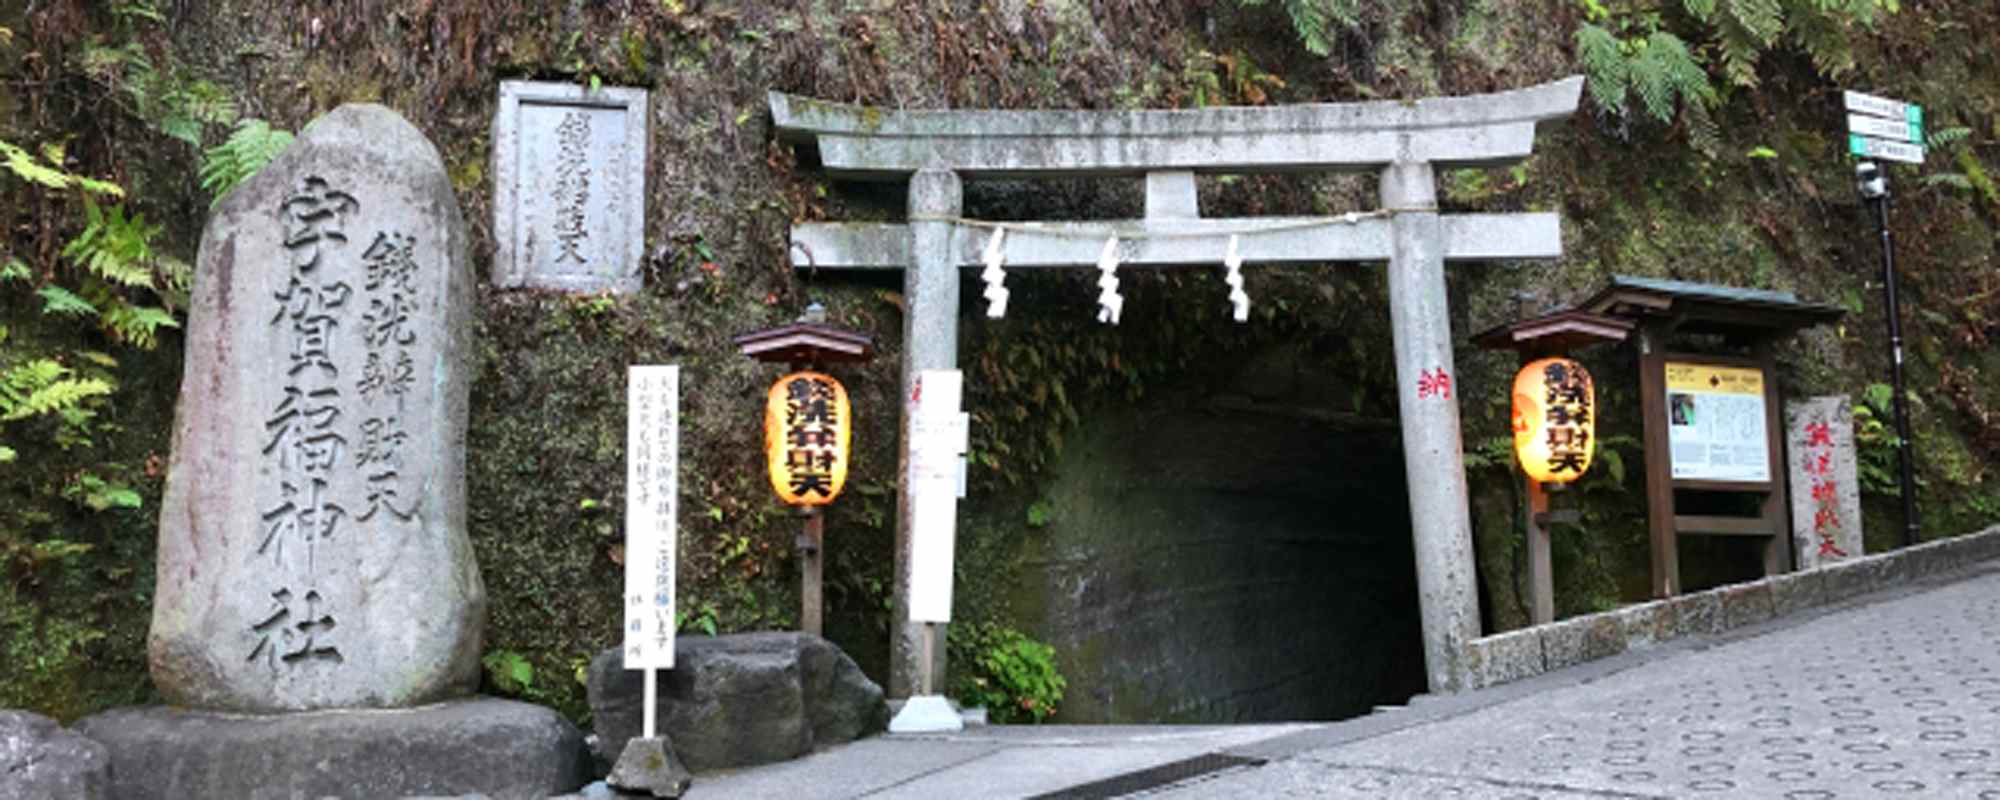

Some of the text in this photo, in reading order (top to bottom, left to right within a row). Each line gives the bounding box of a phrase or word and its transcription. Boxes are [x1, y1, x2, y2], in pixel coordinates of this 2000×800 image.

[246, 175, 361, 667] 宇賀福神社
[1417, 367, 1452, 401] 納
